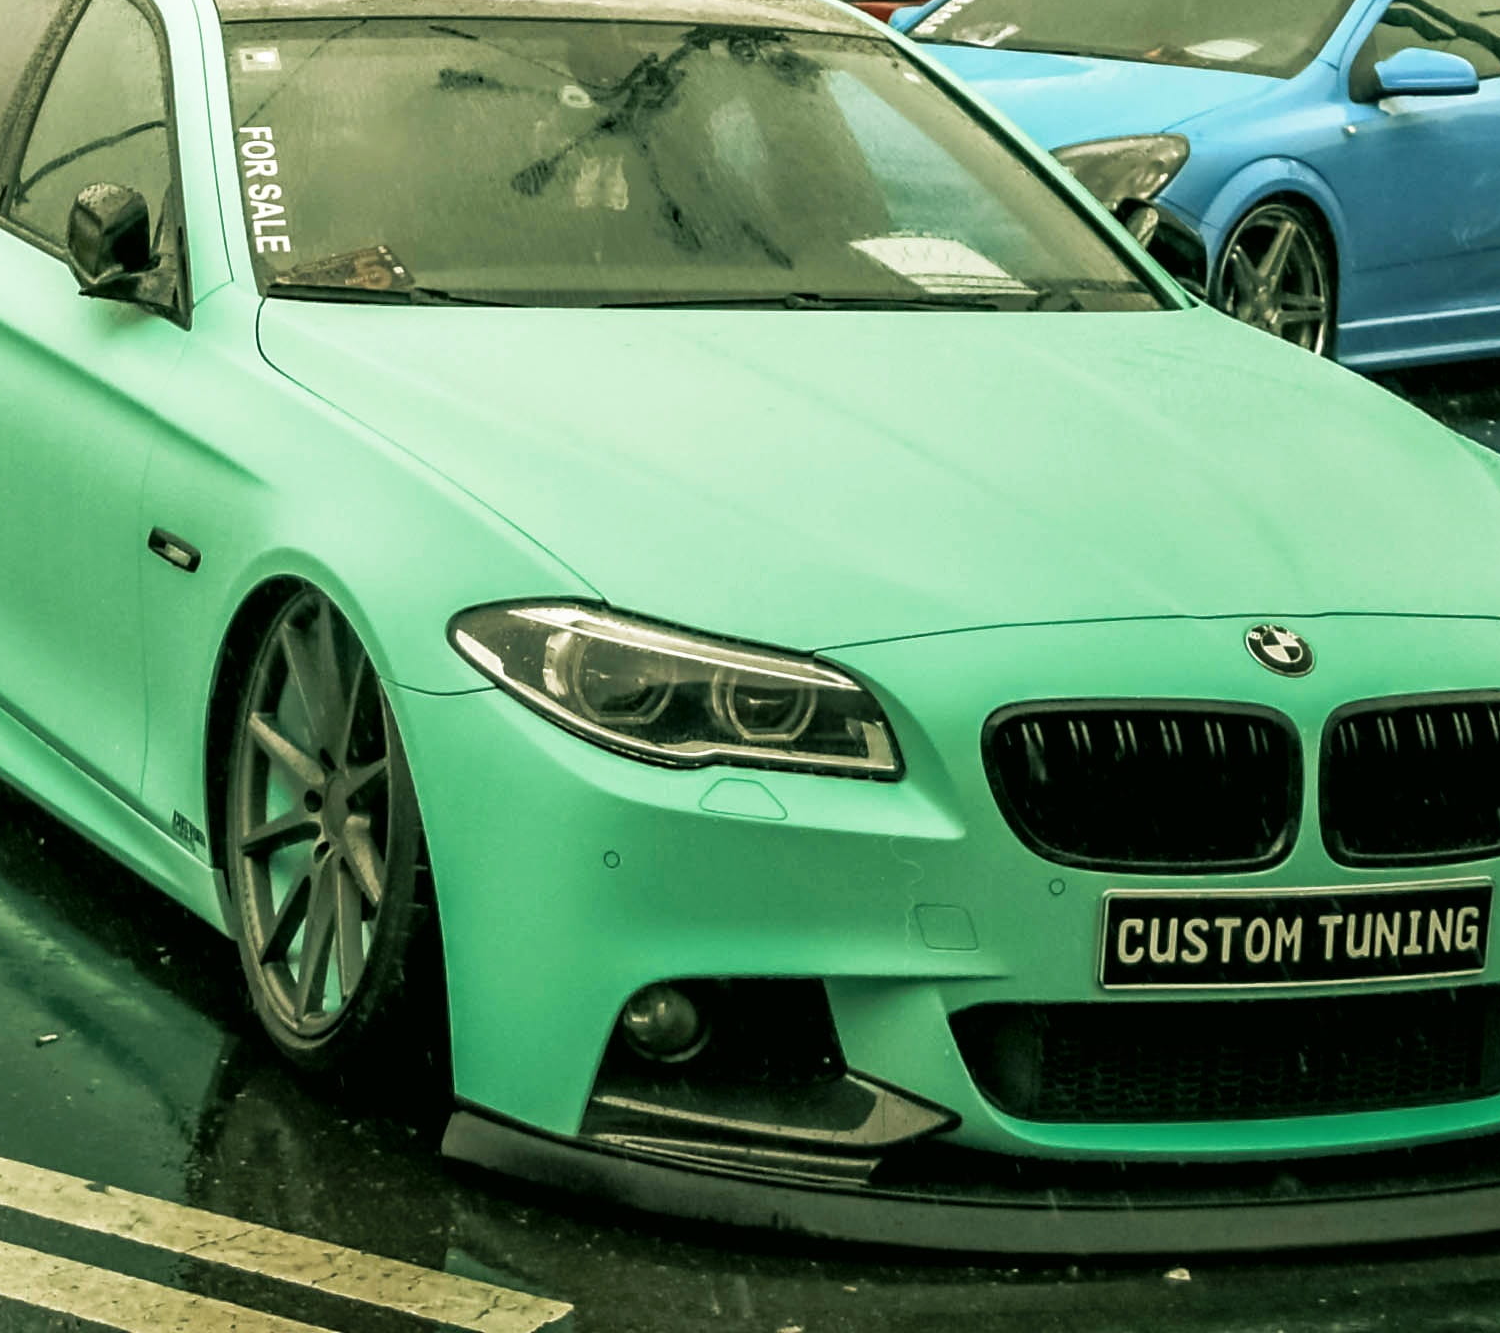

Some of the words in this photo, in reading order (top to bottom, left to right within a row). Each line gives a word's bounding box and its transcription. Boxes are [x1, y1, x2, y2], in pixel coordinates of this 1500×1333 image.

[239, 126, 279, 179] FOR
[248, 183, 292, 255] SALE
[1117, 917, 1303, 964] CUSTOM
[1319, 906, 1481, 960] TUNING
